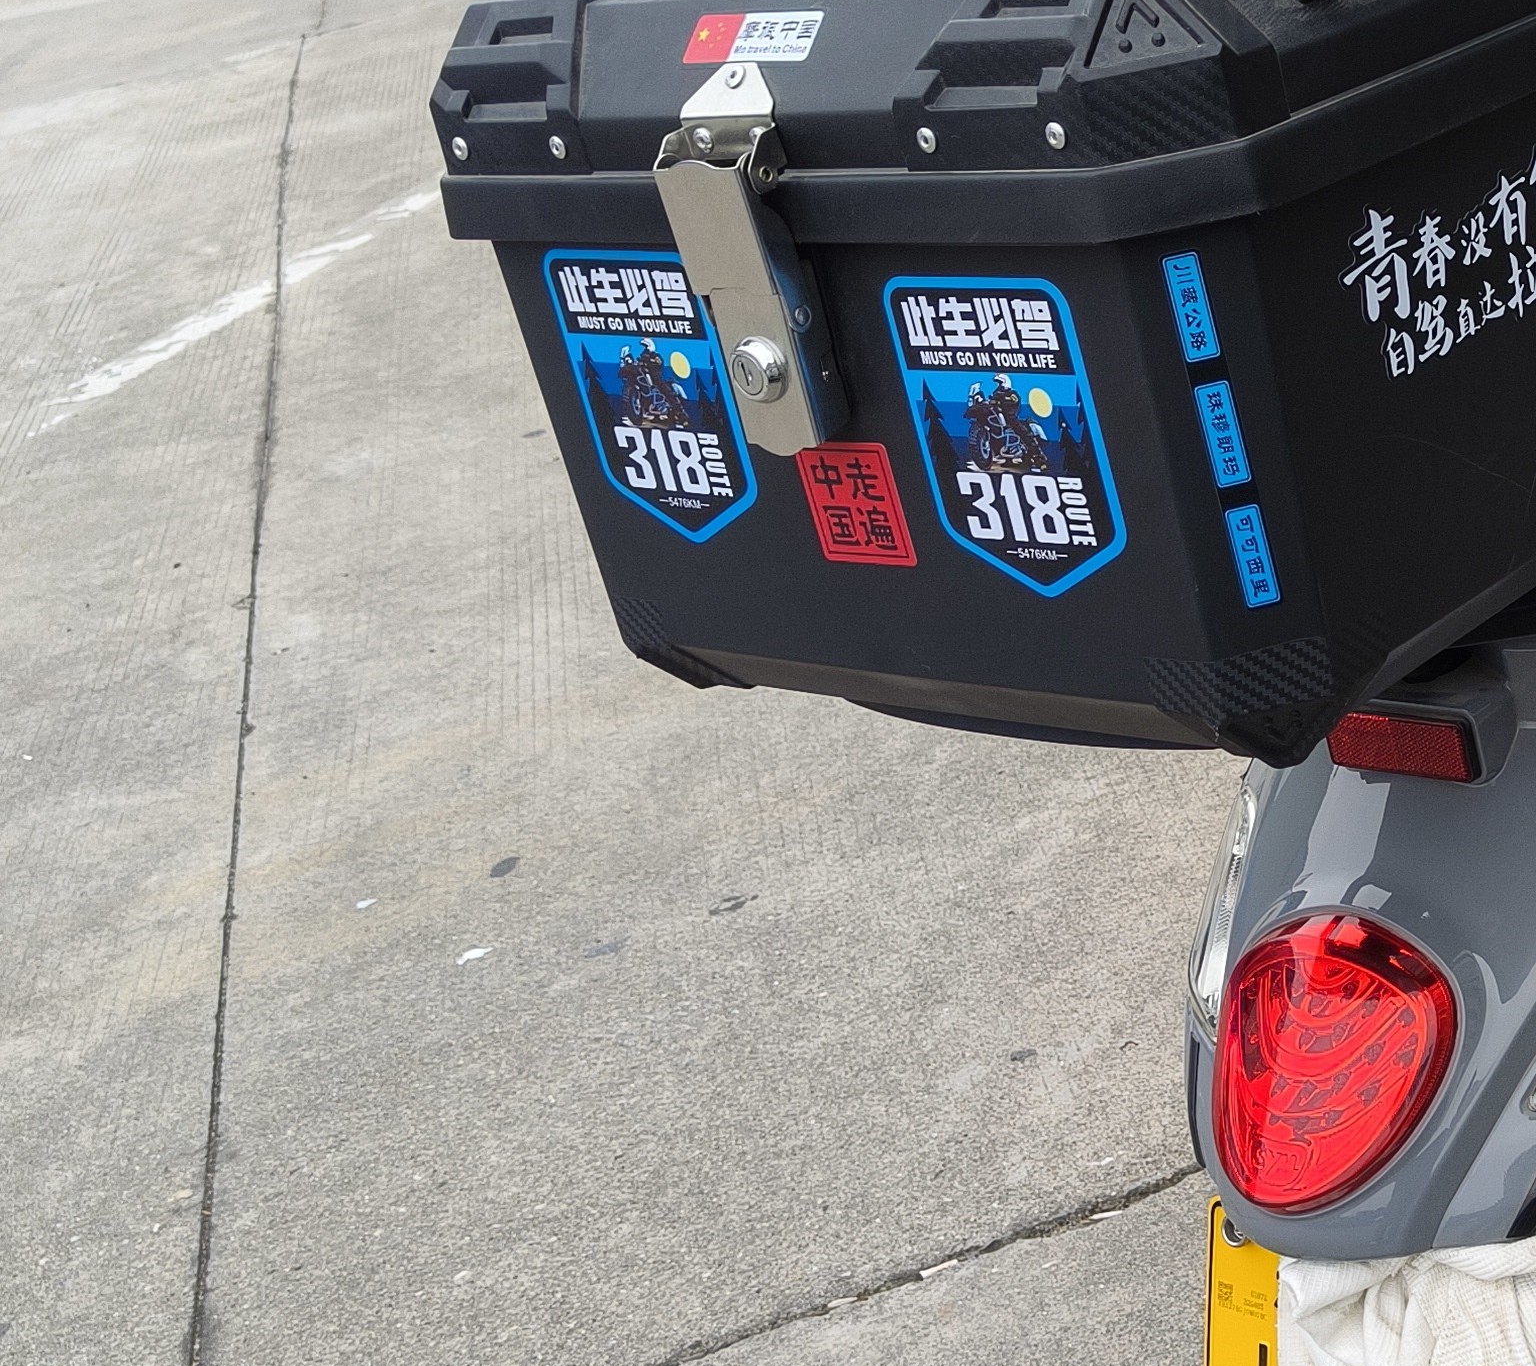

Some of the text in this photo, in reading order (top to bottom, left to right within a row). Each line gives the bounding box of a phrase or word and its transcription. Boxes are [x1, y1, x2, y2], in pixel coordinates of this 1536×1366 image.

[747, 44, 771, 54] travel
[782, 43, 807, 54] China
[558, 266, 694, 318] 此生必驾
[577, 316, 692, 334] MUST GO IN YOUR LIFE
[900, 296, 1059, 351] 此生必驾
[1173, 264, 1207, 351] 川藏公路
[920, 351, 1057, 368] MUST GO IN YOUR LIFE
[614, 426, 710, 495] 318
[697, 433, 733, 497] ROUTE
[1207, 392, 1240, 475] 珠穆朗玛
[956, 472, 1070, 544] 318
[1057, 477, 1097, 546] ROUTE
[1236, 514, 1270, 598] 可可西里
